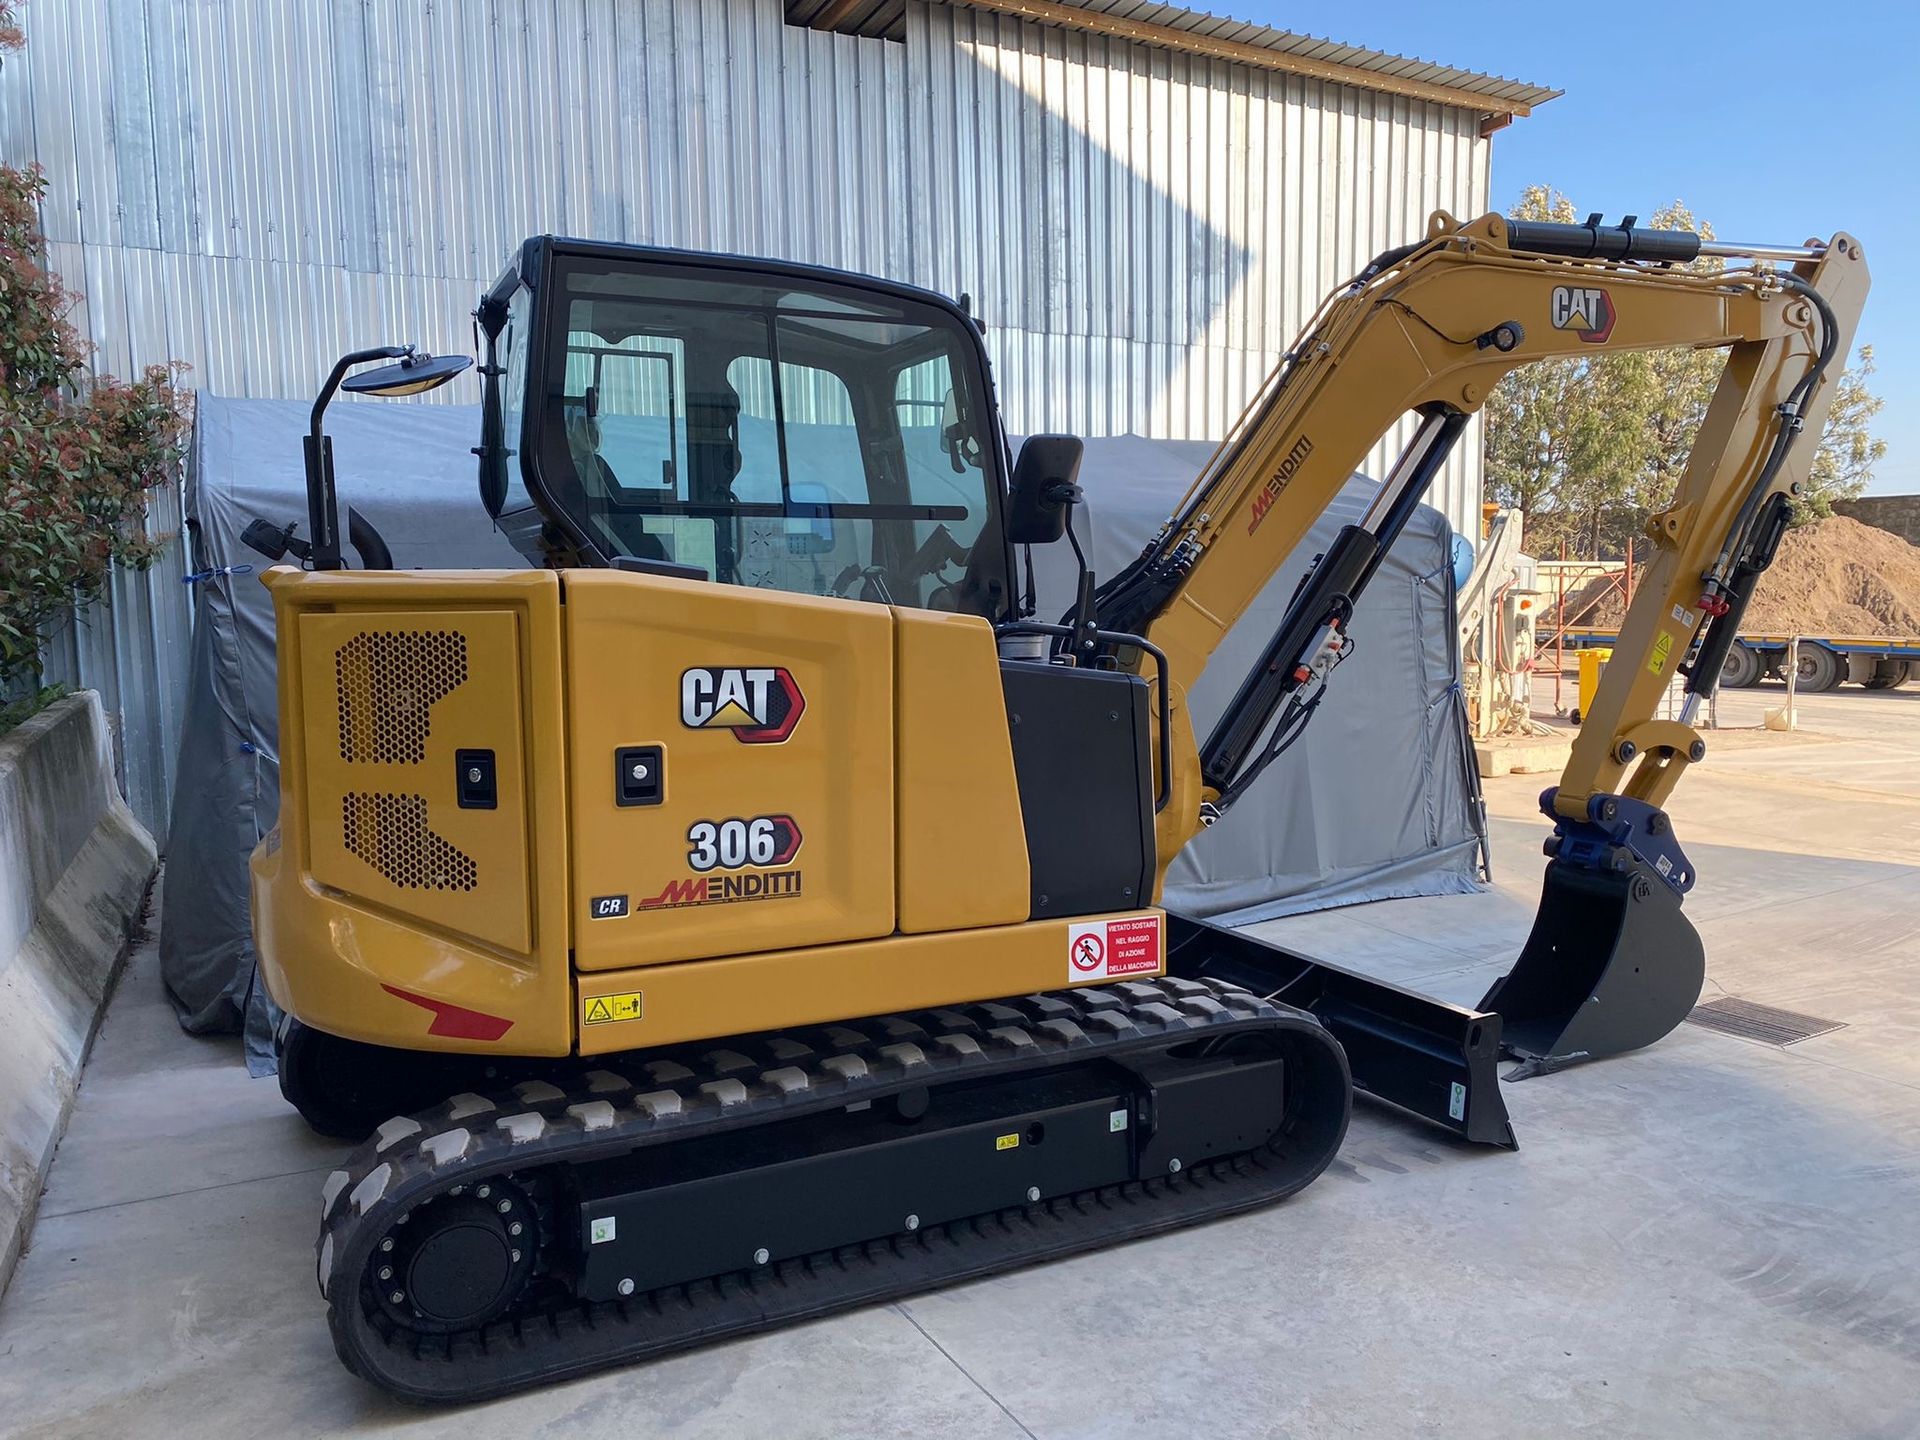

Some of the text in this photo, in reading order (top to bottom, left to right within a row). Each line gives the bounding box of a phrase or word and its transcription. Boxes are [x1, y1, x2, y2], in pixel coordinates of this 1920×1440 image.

[1552, 286, 1602, 330] CAT
[1247, 434, 1313, 536] MENDITTI
[682, 668, 776, 727] CAT
[689, 817, 775, 870] 306
[639, 870, 802, 906] MENDITTI
[599, 898, 622, 915] CR
[1108, 921, 1157, 932] VIETATO SOSTARE
[1115, 935, 1150, 945] NEL RAGGIO
[1125, 948, 1145, 956] AZIONE
[1108, 960, 1157, 973] DELLA MACCHINA
